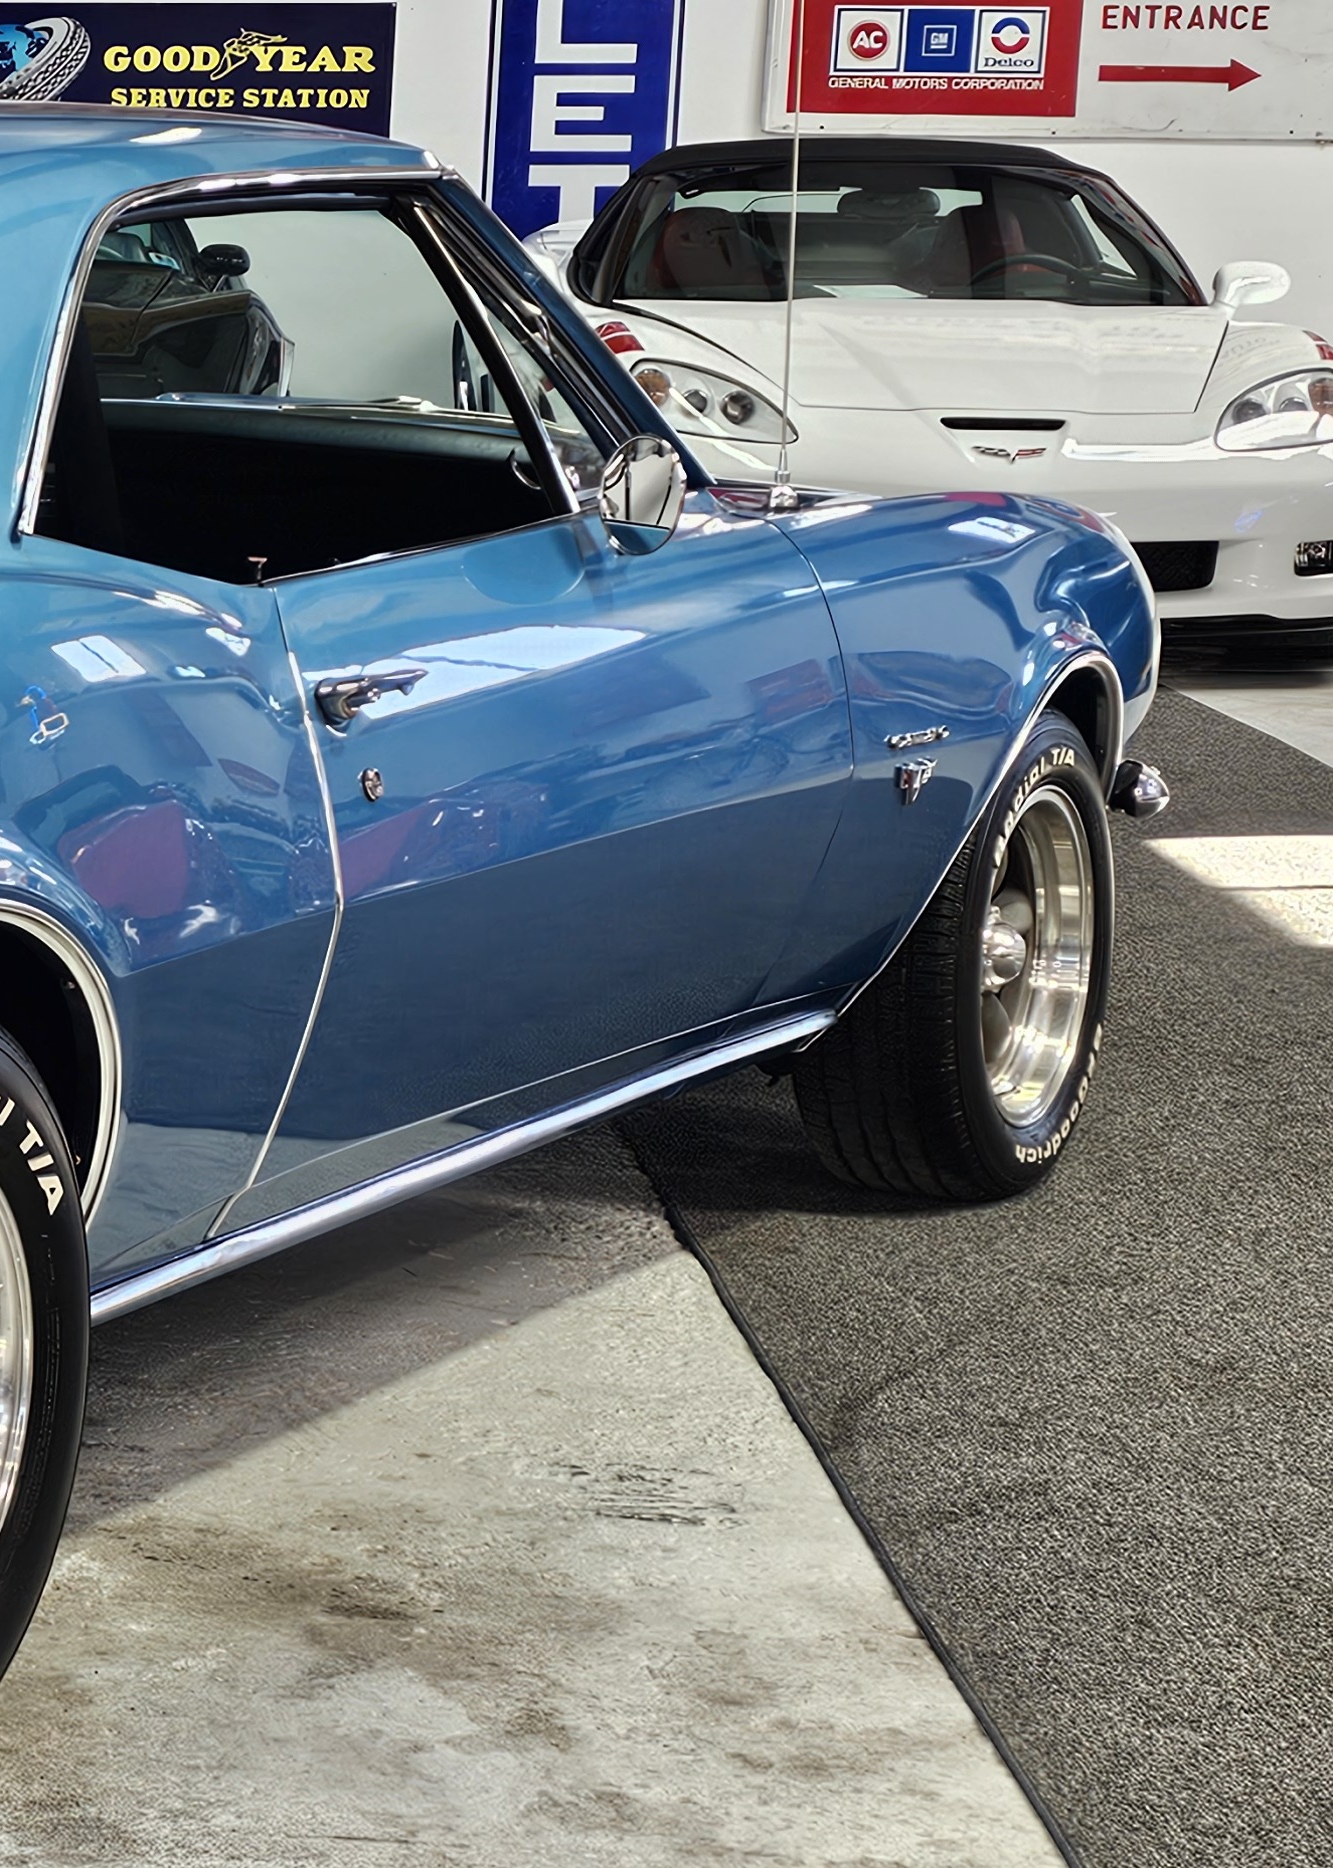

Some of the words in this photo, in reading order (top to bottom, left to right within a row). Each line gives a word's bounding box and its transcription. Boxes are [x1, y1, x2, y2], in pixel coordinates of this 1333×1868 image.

[1101, 5, 1271, 30] ENTRANCE
[852, 30, 884, 49] AC
[929, 32, 949, 46] GM
[983, 56, 1035, 68] Delco
[828, 77, 889, 89] GENERAL
[892, 78, 948, 90] MOTORS
[951, 78, 1045, 91] CORPORATION
[110, 88, 235, 108] SERVICE
[242, 88, 371, 108] STATION
[528, 0, 638, 222] LET
[1051, 746, 1075, 767] T/A
[18, 1119, 65, 1217] T/A
